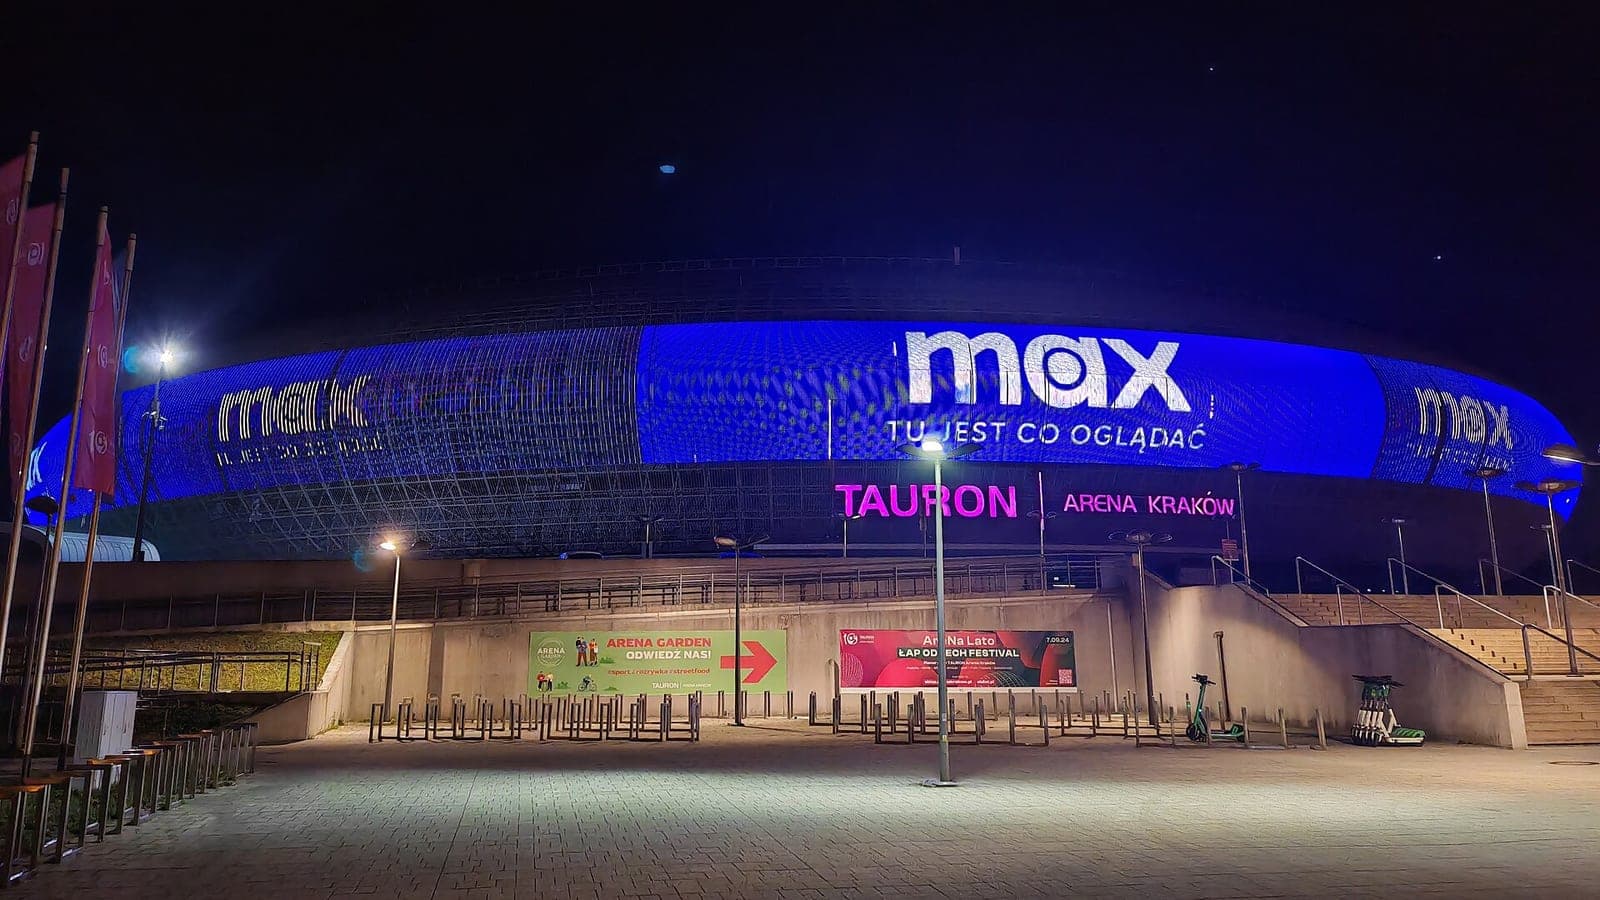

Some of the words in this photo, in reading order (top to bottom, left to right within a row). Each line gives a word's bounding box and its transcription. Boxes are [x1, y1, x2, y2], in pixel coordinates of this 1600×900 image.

[907, 330, 1191, 412] max
[1415, 387, 1514, 449] max
[888, 420, 925, 443] TU
[941, 421, 1006, 443] JEST
[1017, 422, 1059, 445] CO
[1071, 423, 1207, 454] OGLĄDAĆ
[835, 483, 1017, 519] TAURON
[1063, 493, 1137, 514] ARENA
[1147, 490, 1236, 516] KRAKÓW
[607, 638, 653, 648] ARENA
[656, 637, 712, 648] GARDEN
[923, 635, 964, 646] ArNa
[967, 635, 995, 646] Lato
[537, 647, 566, 655] ARENA
[626, 648, 681, 660] ODWIEDŹ
[683, 650, 711, 659] NAS!
[898, 648, 921, 657] ŁAP
[923, 648, 967, 657] ODECH
[969, 648, 1019, 657] FESTIVAL
